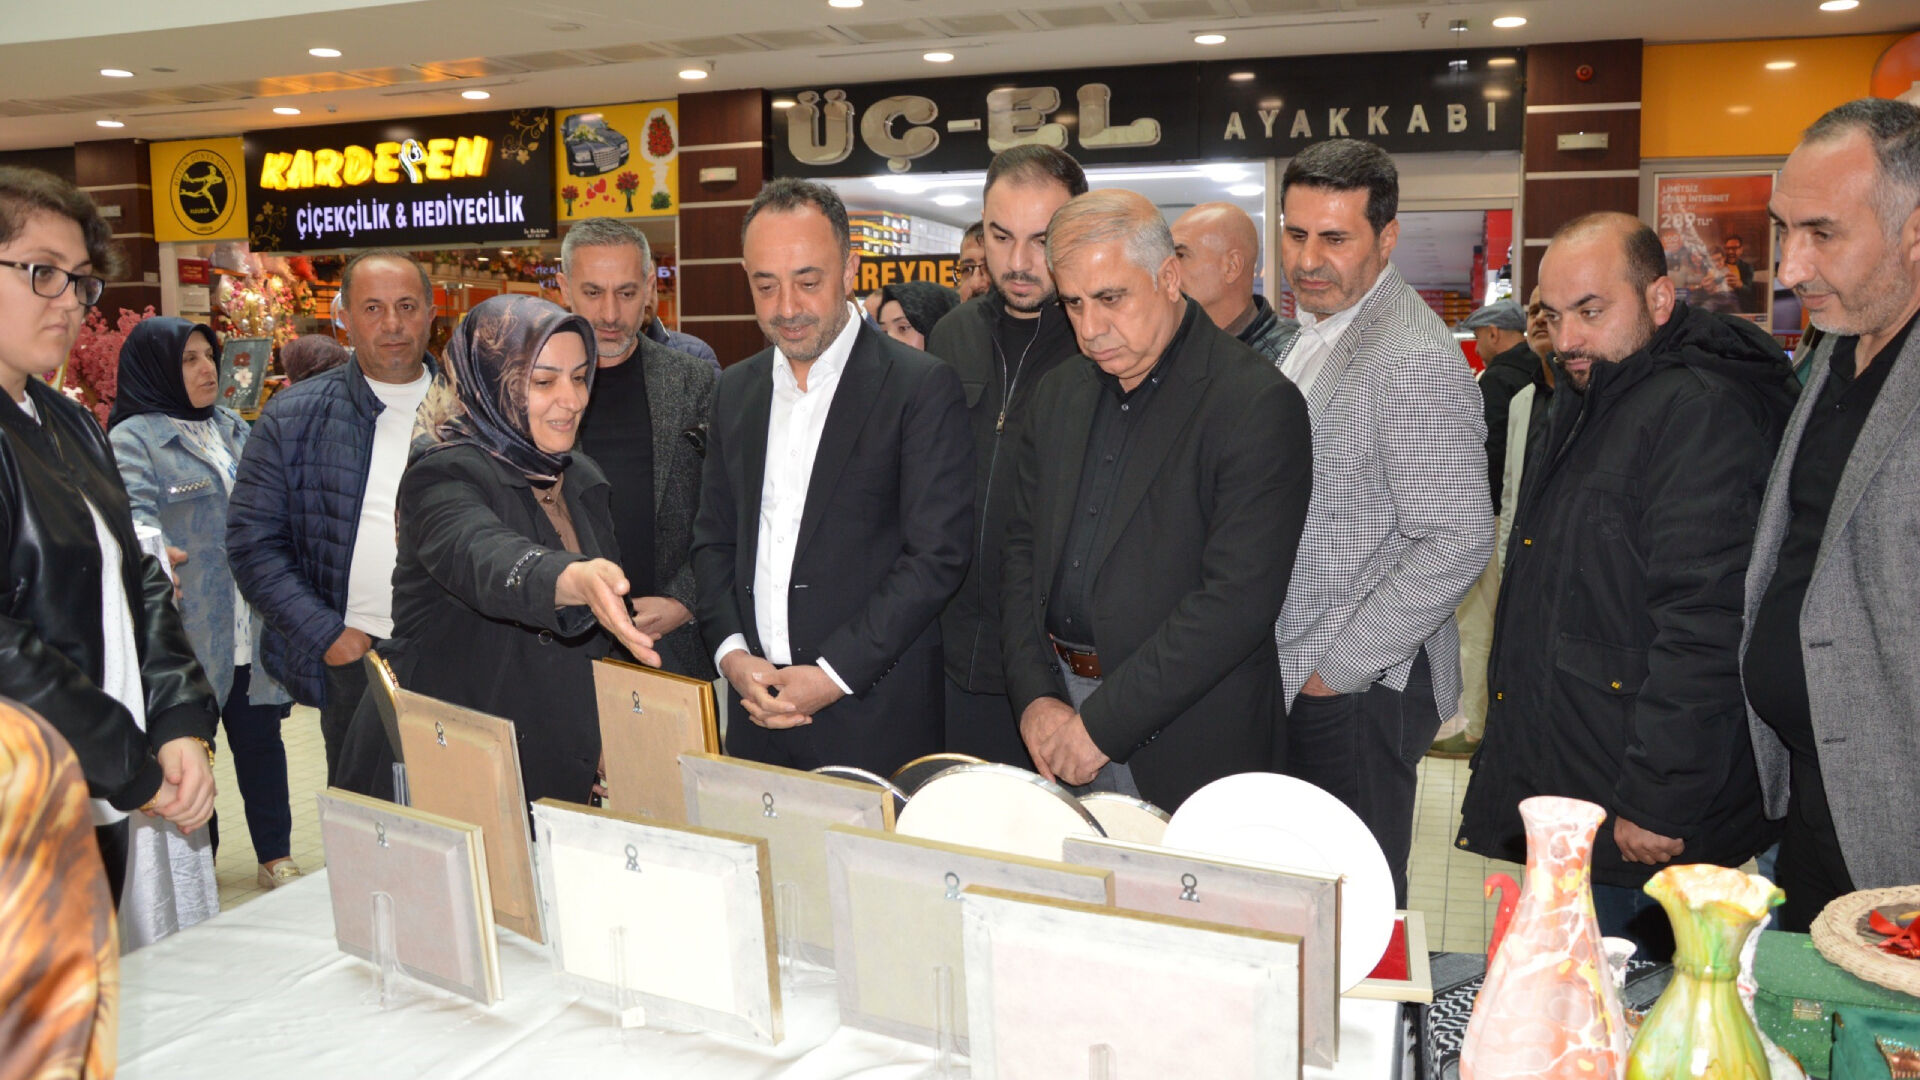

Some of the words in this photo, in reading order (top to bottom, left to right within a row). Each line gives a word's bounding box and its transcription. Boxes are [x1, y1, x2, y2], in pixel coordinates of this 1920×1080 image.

[786, 82, 1162, 174] ÜÇ-EL
[1223, 101, 1497, 141] AYAKKABI
[295, 197, 391, 241] ÇİÇEKÇİLİK
[394, 201, 408, 229] &
[411, 189, 526, 228] HEDİYECİLİK
[1660, 211, 1697, 229] 289
[853, 259, 962, 292] REYDE
